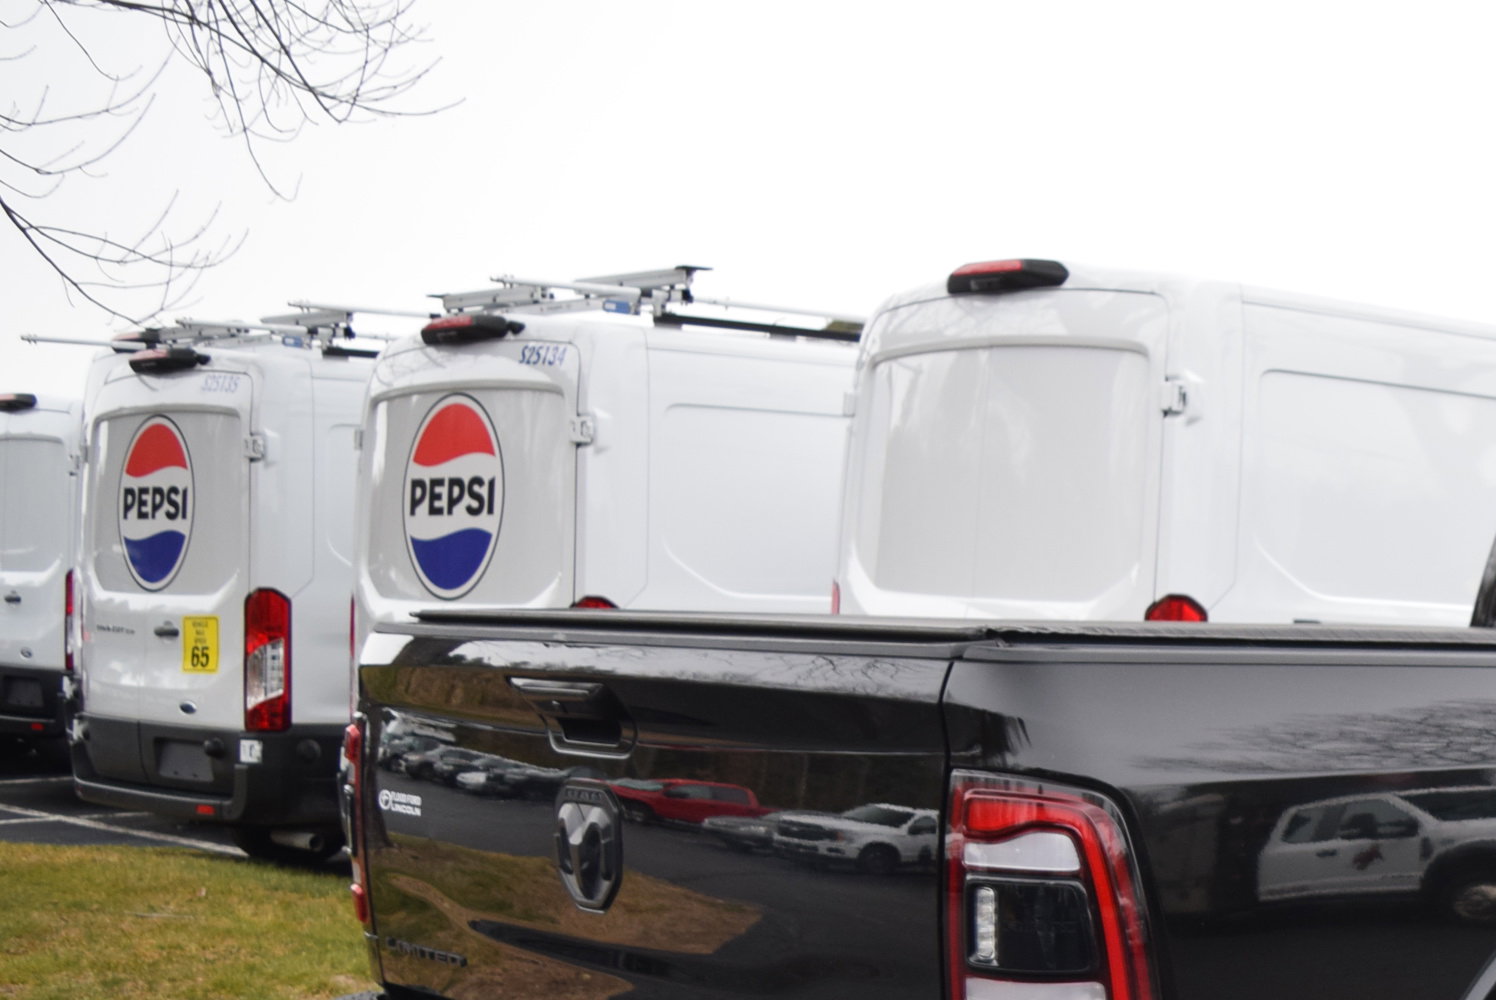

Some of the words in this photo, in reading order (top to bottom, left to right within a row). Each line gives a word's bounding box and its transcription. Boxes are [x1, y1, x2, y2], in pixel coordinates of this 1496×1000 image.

[519, 344, 567, 366] S25134
[123, 486, 188, 520] PEPSI
[410, 476, 496, 517] PEPSI
[191, 646, 210, 668] 65
[387, 937, 467, 968] LIMITED
